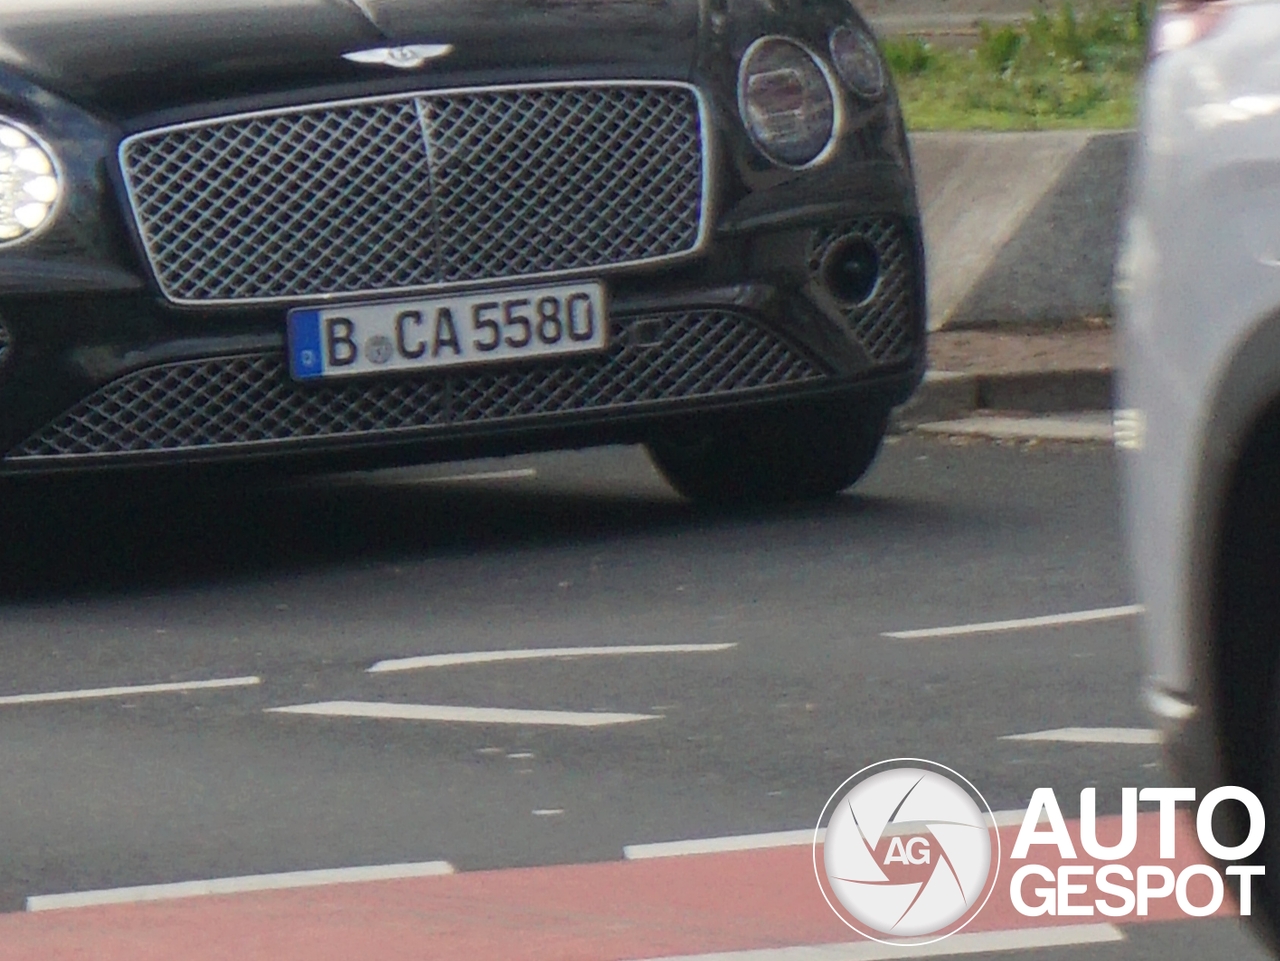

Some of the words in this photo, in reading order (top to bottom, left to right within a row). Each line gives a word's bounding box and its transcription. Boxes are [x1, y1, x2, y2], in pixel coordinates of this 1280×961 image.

[325, 317, 357, 366] B
[395, 307, 461, 360] CA
[472, 292, 593, 352] 5580
